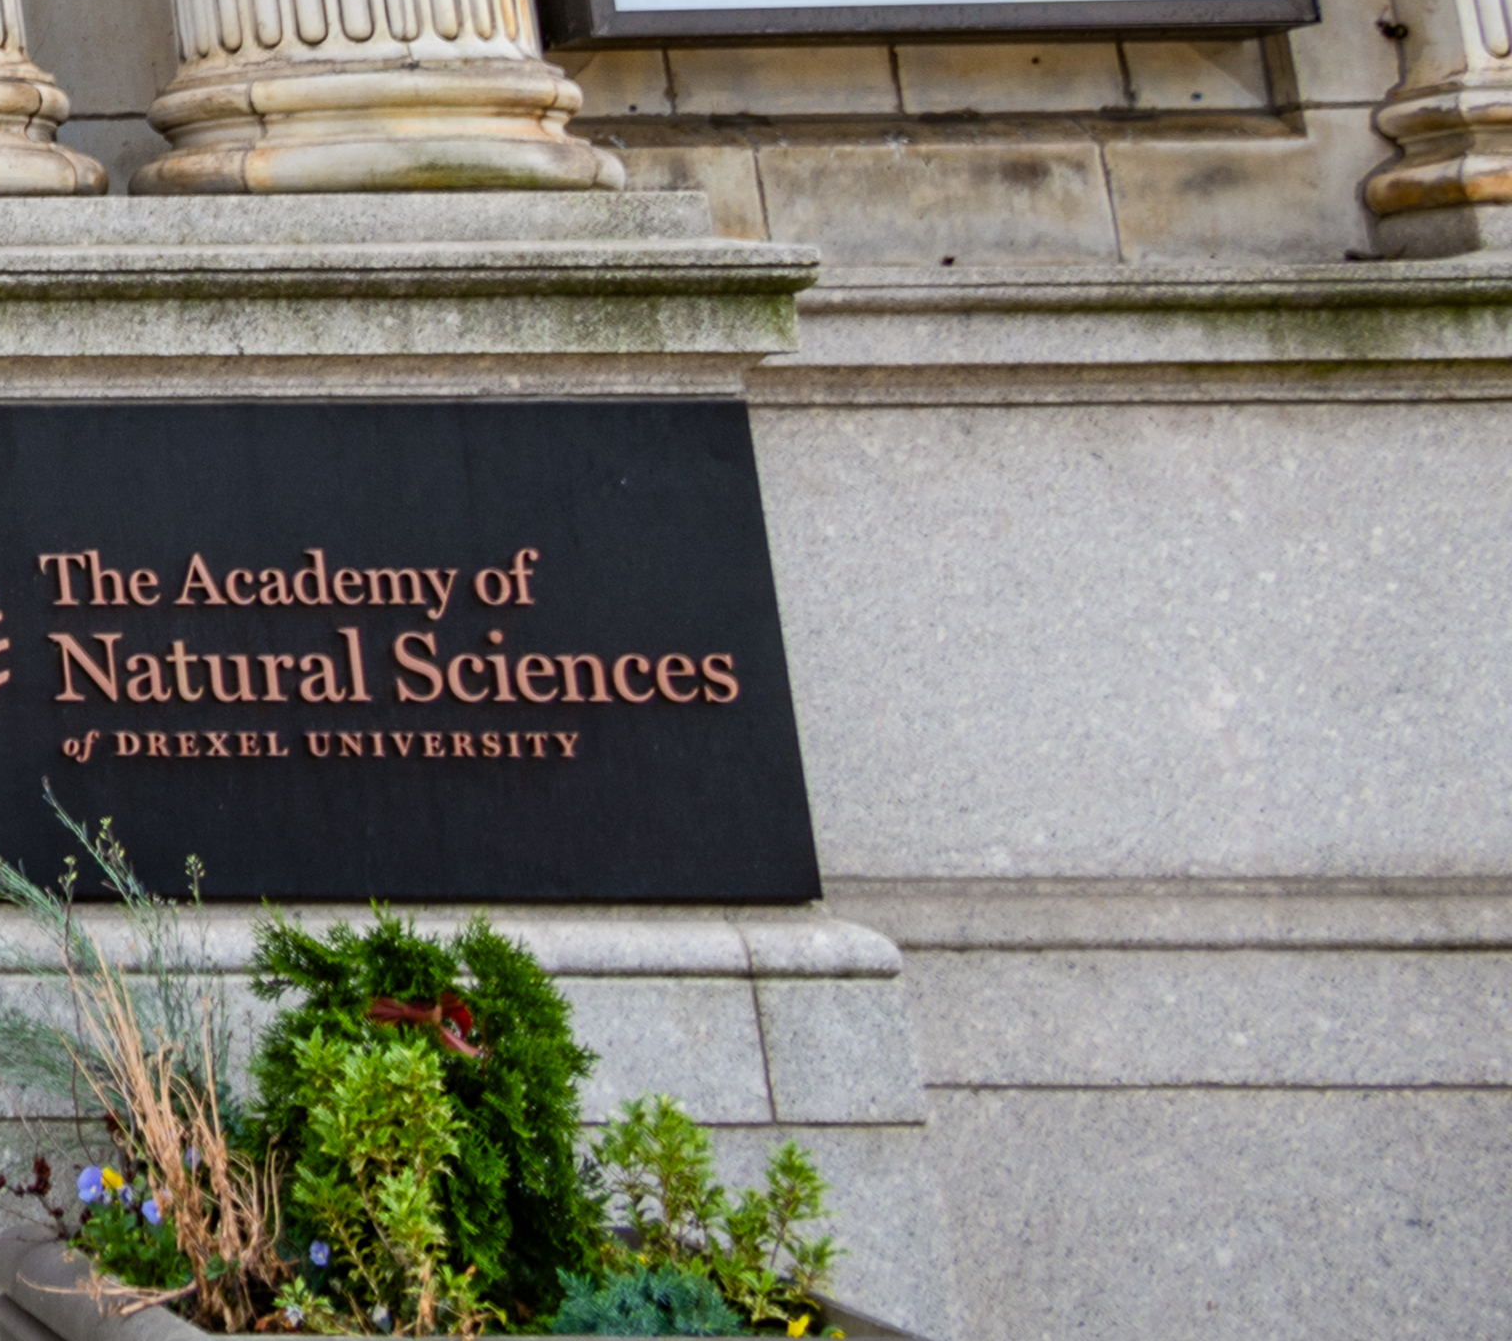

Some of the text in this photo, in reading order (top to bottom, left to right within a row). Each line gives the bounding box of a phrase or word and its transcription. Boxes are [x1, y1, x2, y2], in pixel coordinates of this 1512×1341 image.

[39, 547, 539, 618] The Academy of
[50, 627, 739, 704] Natural Sciences
[63, 729, 580, 762] of DREXEL UNIVERSITY
